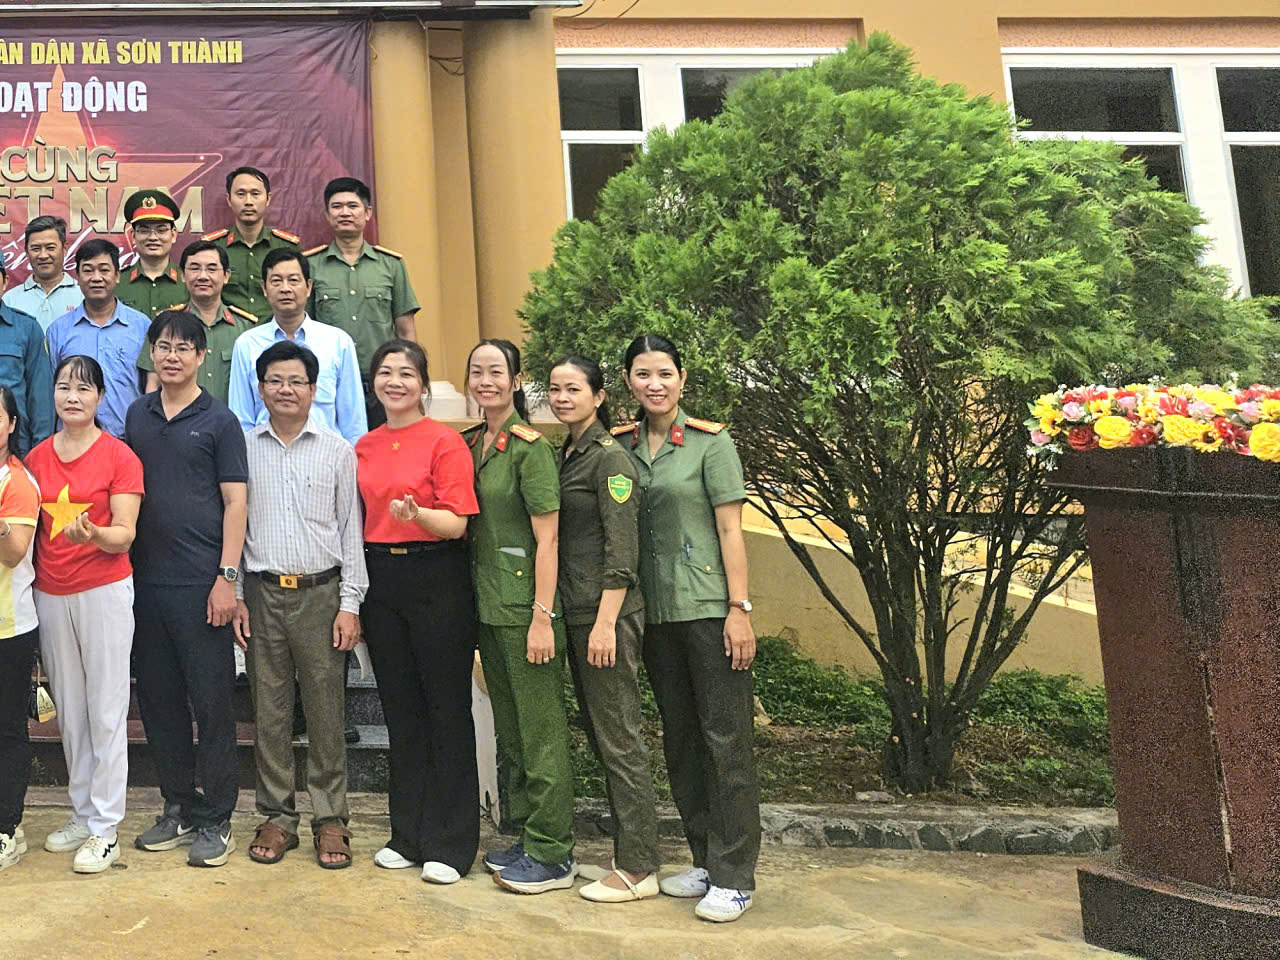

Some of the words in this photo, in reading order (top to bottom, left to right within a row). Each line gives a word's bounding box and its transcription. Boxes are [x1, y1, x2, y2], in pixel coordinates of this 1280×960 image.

[30, 38, 75, 65] DÂN
[81, 38, 111, 64] XÃ
[116, 38, 161, 64] SƠN
[168, 37, 243, 64] THÀNH
[61, 76, 148, 118] ĐỘNG
[0, 135, 118, 183] CÙNG
